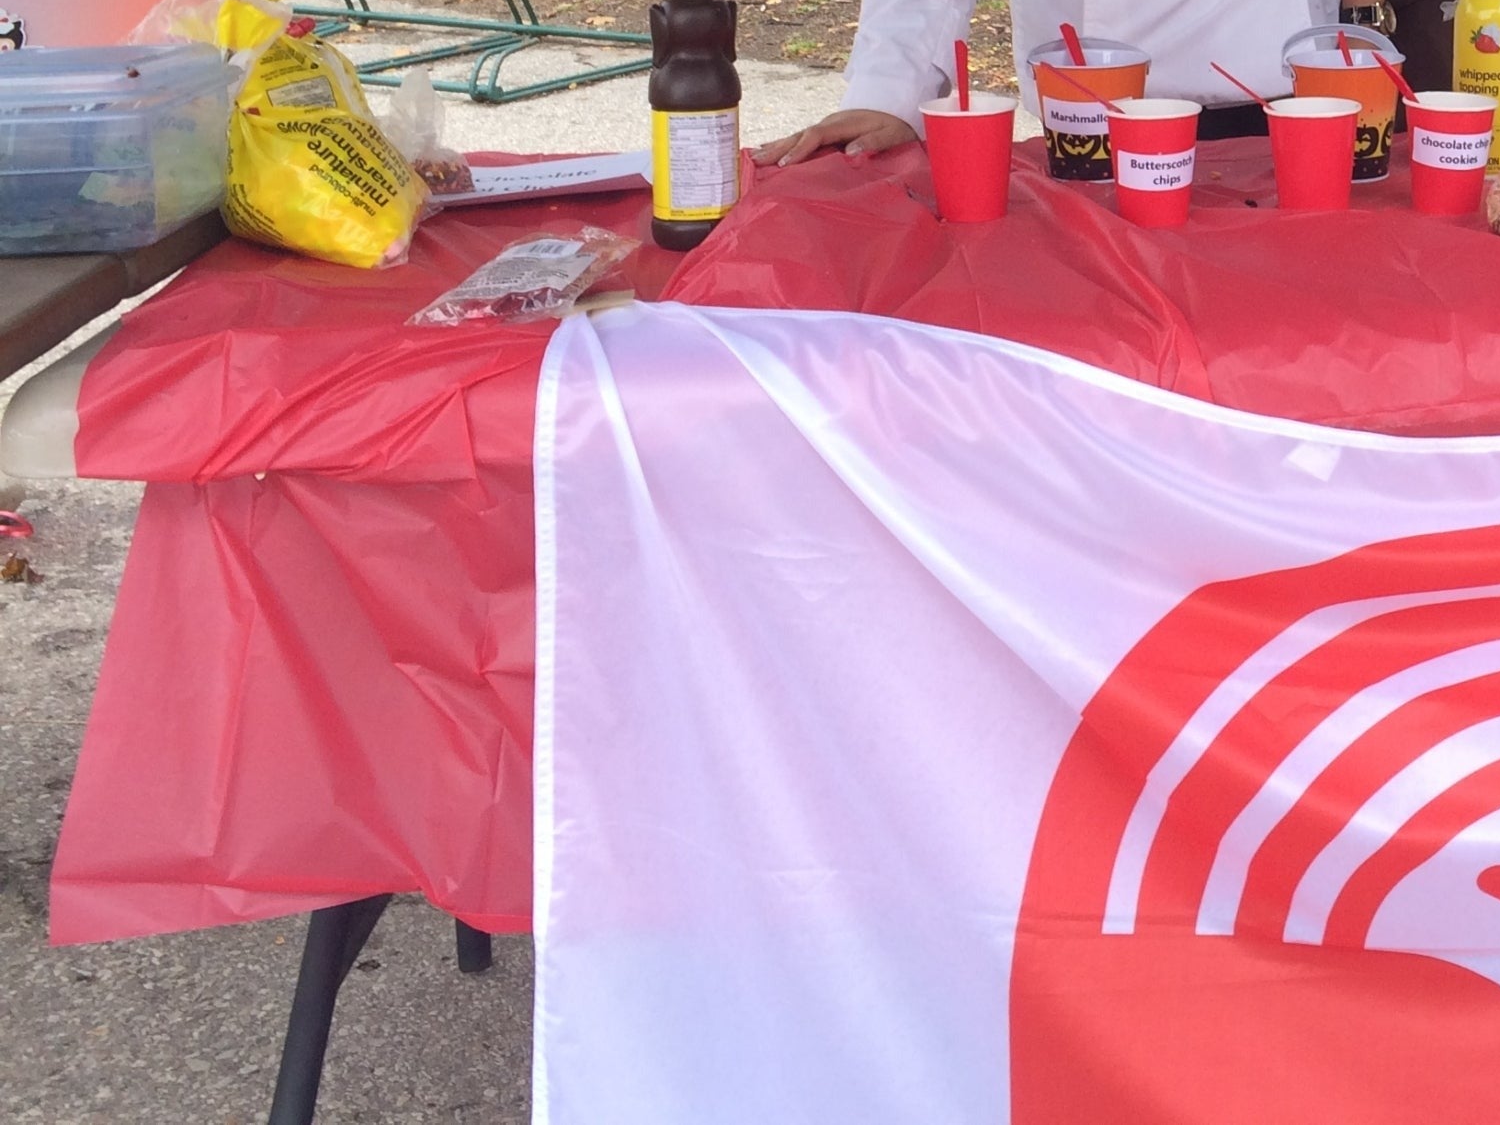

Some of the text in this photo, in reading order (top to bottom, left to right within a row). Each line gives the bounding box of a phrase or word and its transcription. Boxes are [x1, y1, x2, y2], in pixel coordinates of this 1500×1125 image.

[1421, 136, 1473, 150] chocolate
[276, 119, 398, 198] marshmallows
[1130, 155, 1193, 171] Butterscotch
[1439, 153, 1478, 165] cookies
[306, 140, 390, 209] miniature
[1153, 174, 1181, 187] chips
[307, 164, 377, 218] multi-coloured
